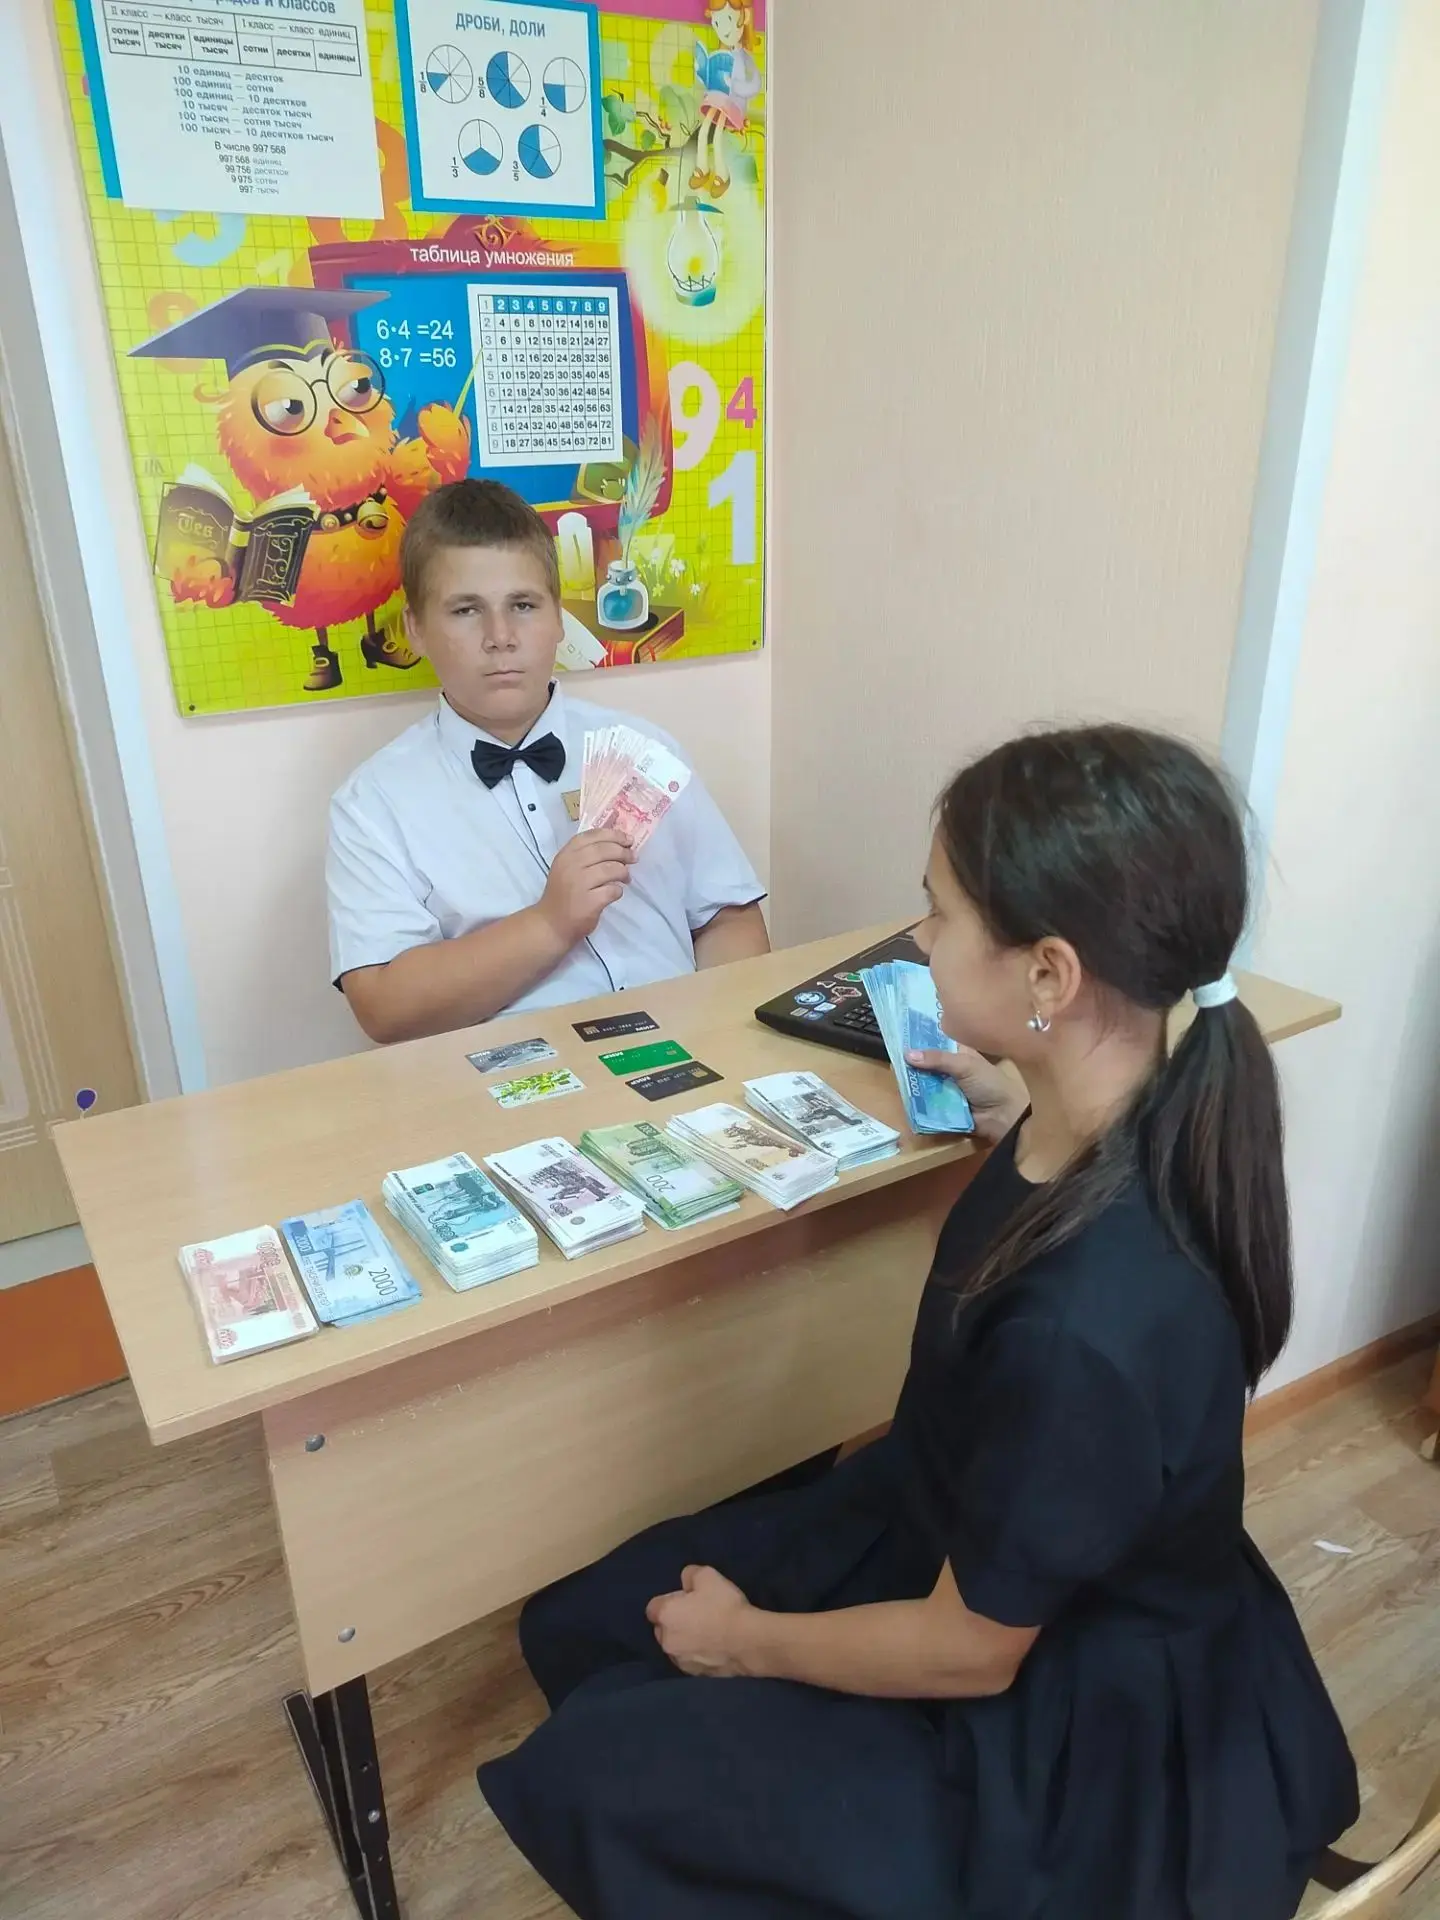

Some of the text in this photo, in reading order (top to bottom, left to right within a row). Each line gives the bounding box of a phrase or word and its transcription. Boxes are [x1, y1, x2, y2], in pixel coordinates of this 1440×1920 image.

[120, 9, 224, 25] класс класс тысяч
[248, 21, 274, 31] класс
[289, 25, 314, 35] класс
[509, 20, 546, 37] ДОЛИ
[178, 65, 190, 74] 10
[173, 76, 192, 86] 100
[175, 88, 193, 97] 100
[249, 94, 260, 103] 10
[183, 100, 195, 109] 10
[178, 111, 196, 120] 100
[180, 123, 198, 132] 100
[246, 128, 257, 137] 10
[214, 141, 286, 154] В числе 997 568
[410, 247, 574, 268] таблица умножения
[497, 300, 505, 310] 2
[512, 300, 520, 311] 3
[526, 300, 535, 311] 4
[541, 300, 549, 311] 5
[556, 300, 564, 311] 6
[570, 301, 578, 312] 7
[584, 301, 592, 312] 8
[598, 301, 606, 312] 9
[416, 319, 454, 341] =24
[499, 318, 505, 328] 4
[514, 318, 520, 328] 6
[528, 319, 535, 328] 8
[541, 319, 552, 328] 10
[555, 319, 566, 328] 12
[570, 319, 580, 328] 14
[584, 319, 594, 328] 16
[598, 319, 608, 329] 18
[500, 336, 507, 345] 6
[515, 336, 521, 345] 9
[528, 336, 539, 345] 12
[542, 336, 553, 345] 15
[556, 337, 567, 346] 18
[570, 337, 580, 346] 21
[584, 337, 595, 346] 24
[598, 337, 608, 346] 27
[419, 347, 457, 369] =56
[501, 353, 508, 363] 8
[514, 353, 525, 363] 12
[529, 354, 540, 363] 16
[542, 354, 554, 363] 20
[556, 354, 568, 363] 24
[570, 354, 582, 363] 28
[584, 354, 595, 363] 32
[598, 354, 609, 363] 36
[500, 371, 512, 380] 10
[516, 371, 526, 380] 15
[529, 371, 540, 380] 20
[543, 371, 555, 380] 25
[557, 371, 569, 379] 30
[571, 370, 583, 379] 35
[585, 370, 596, 379] 40
[598, 370, 610, 379] 45
[502, 388, 513, 397] 12
[516, 388, 527, 397] 18
[530, 388, 541, 396] 24
[544, 388, 556, 396] 30
[558, 388, 570, 396] 36
[572, 387, 583, 396] 42
[586, 387, 597, 396] 48
[599, 387, 610, 396] 54
[503, 405, 513, 414] 14
[516, 405, 527, 414] 21
[531, 405, 543, 413] 28
[545, 405, 556, 413] 35
[559, 404, 570, 413] 42
[572, 404, 584, 413] 49
[586, 404, 597, 412] 56
[600, 404, 611, 412] 63
[725, 376, 758, 429] 4
[667, 360, 720, 471] 9
[504, 422, 515, 431] 16
[518, 421, 529, 431] 24
[532, 421, 543, 430] 32
[546, 421, 557, 430] 40
[560, 421, 571, 430] 48
[574, 421, 585, 429] 56
[587, 420, 598, 429] 64
[601, 420, 611, 429] 72
[505, 439, 516, 448] 18
[519, 439, 530, 448] 27
[533, 438, 544, 447] 36
[547, 438, 558, 447] 45
[561, 438, 572, 446] 54
[574, 437, 585, 446] 63
[588, 437, 598, 445] 72
[601, 437, 612, 445] 81
[707, 449, 757, 566] 1
[908, 1069, 921, 1097] 2000
[646, 1174, 676, 1194] 200
[368, 1267, 398, 1296] 2000
